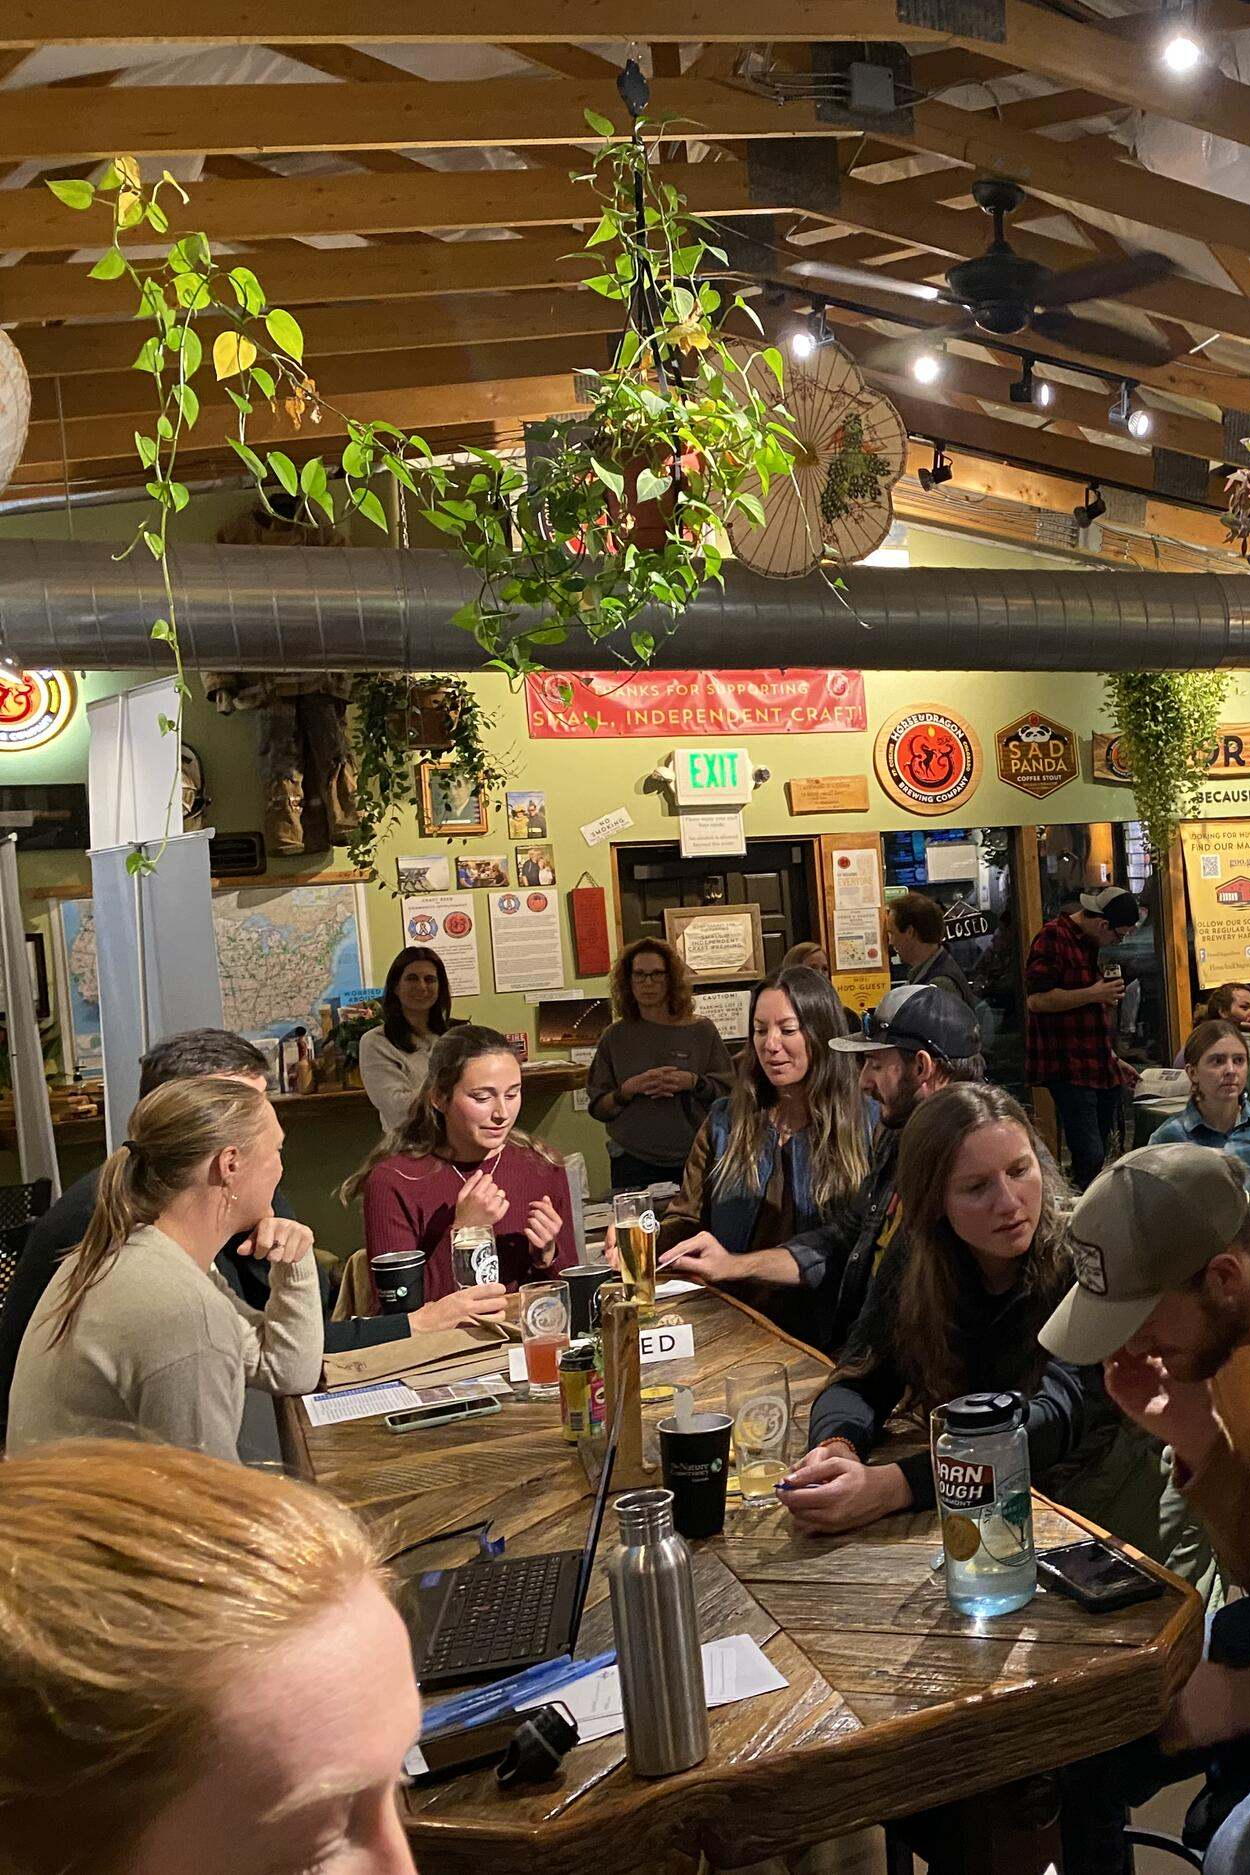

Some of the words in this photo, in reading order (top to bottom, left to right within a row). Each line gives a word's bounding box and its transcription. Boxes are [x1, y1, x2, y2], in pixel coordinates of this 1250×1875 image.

[595, 684, 660, 697] THANKS
[666, 684, 700, 696] FOR
[706, 681, 810, 696] SUPPORTING
[532, 710, 615, 728] SMAL,
[626, 708, 782, 726] INDEPENDENT
[790, 706, 863, 722] CRAFT!
[1008, 740, 1064, 759] SAD
[688, 752, 739, 789] EXIT
[1011, 758, 1068, 773] PANDA
[898, 781, 934, 803] BREWING
[935, 775, 969, 803] COMPANY
[590, 817, 625, 838] SMOKING
[599, 818, 611, 828] NO
[1222, 831, 1237, 839] FOR
[1191, 843, 1211, 852] FIND
[1214, 842, 1234, 851] OUR
[943, 917, 988, 941] LOSED
[1197, 920, 1224, 928] OLLOW
[1212, 926, 1245, 934] REGULAR
[1202, 933, 1237, 942] BREWERY
[938, 1460, 984, 1483] ARN
[940, 1481, 983, 1499] OUGH
